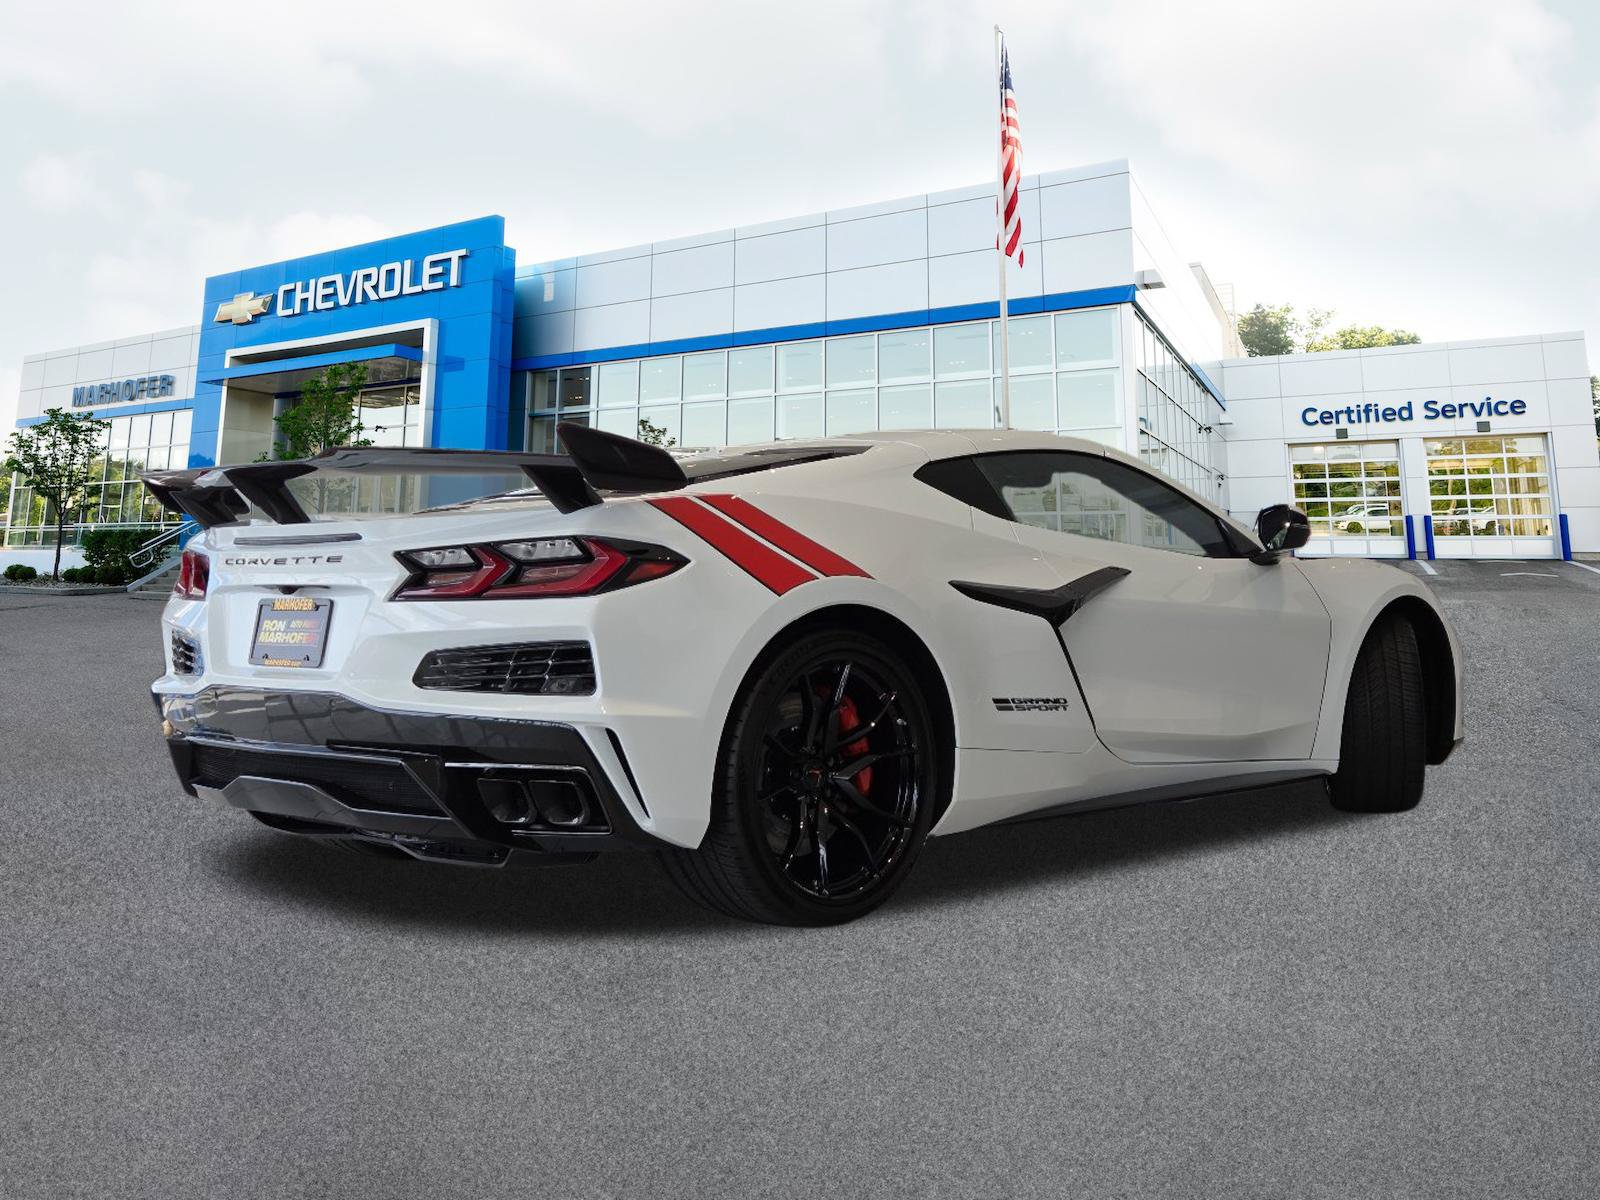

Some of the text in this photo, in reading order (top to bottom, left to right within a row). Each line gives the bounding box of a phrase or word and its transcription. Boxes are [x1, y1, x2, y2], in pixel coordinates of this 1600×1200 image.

[276, 247, 470, 317] CHEVROLET
[72, 375, 176, 407] MARHOFER
[1301, 396, 1527, 426] Certified Service
[225, 555, 343, 565] CORVETTE
[262, 619, 287, 632] RON
[258, 631, 317, 645] MARHOF
